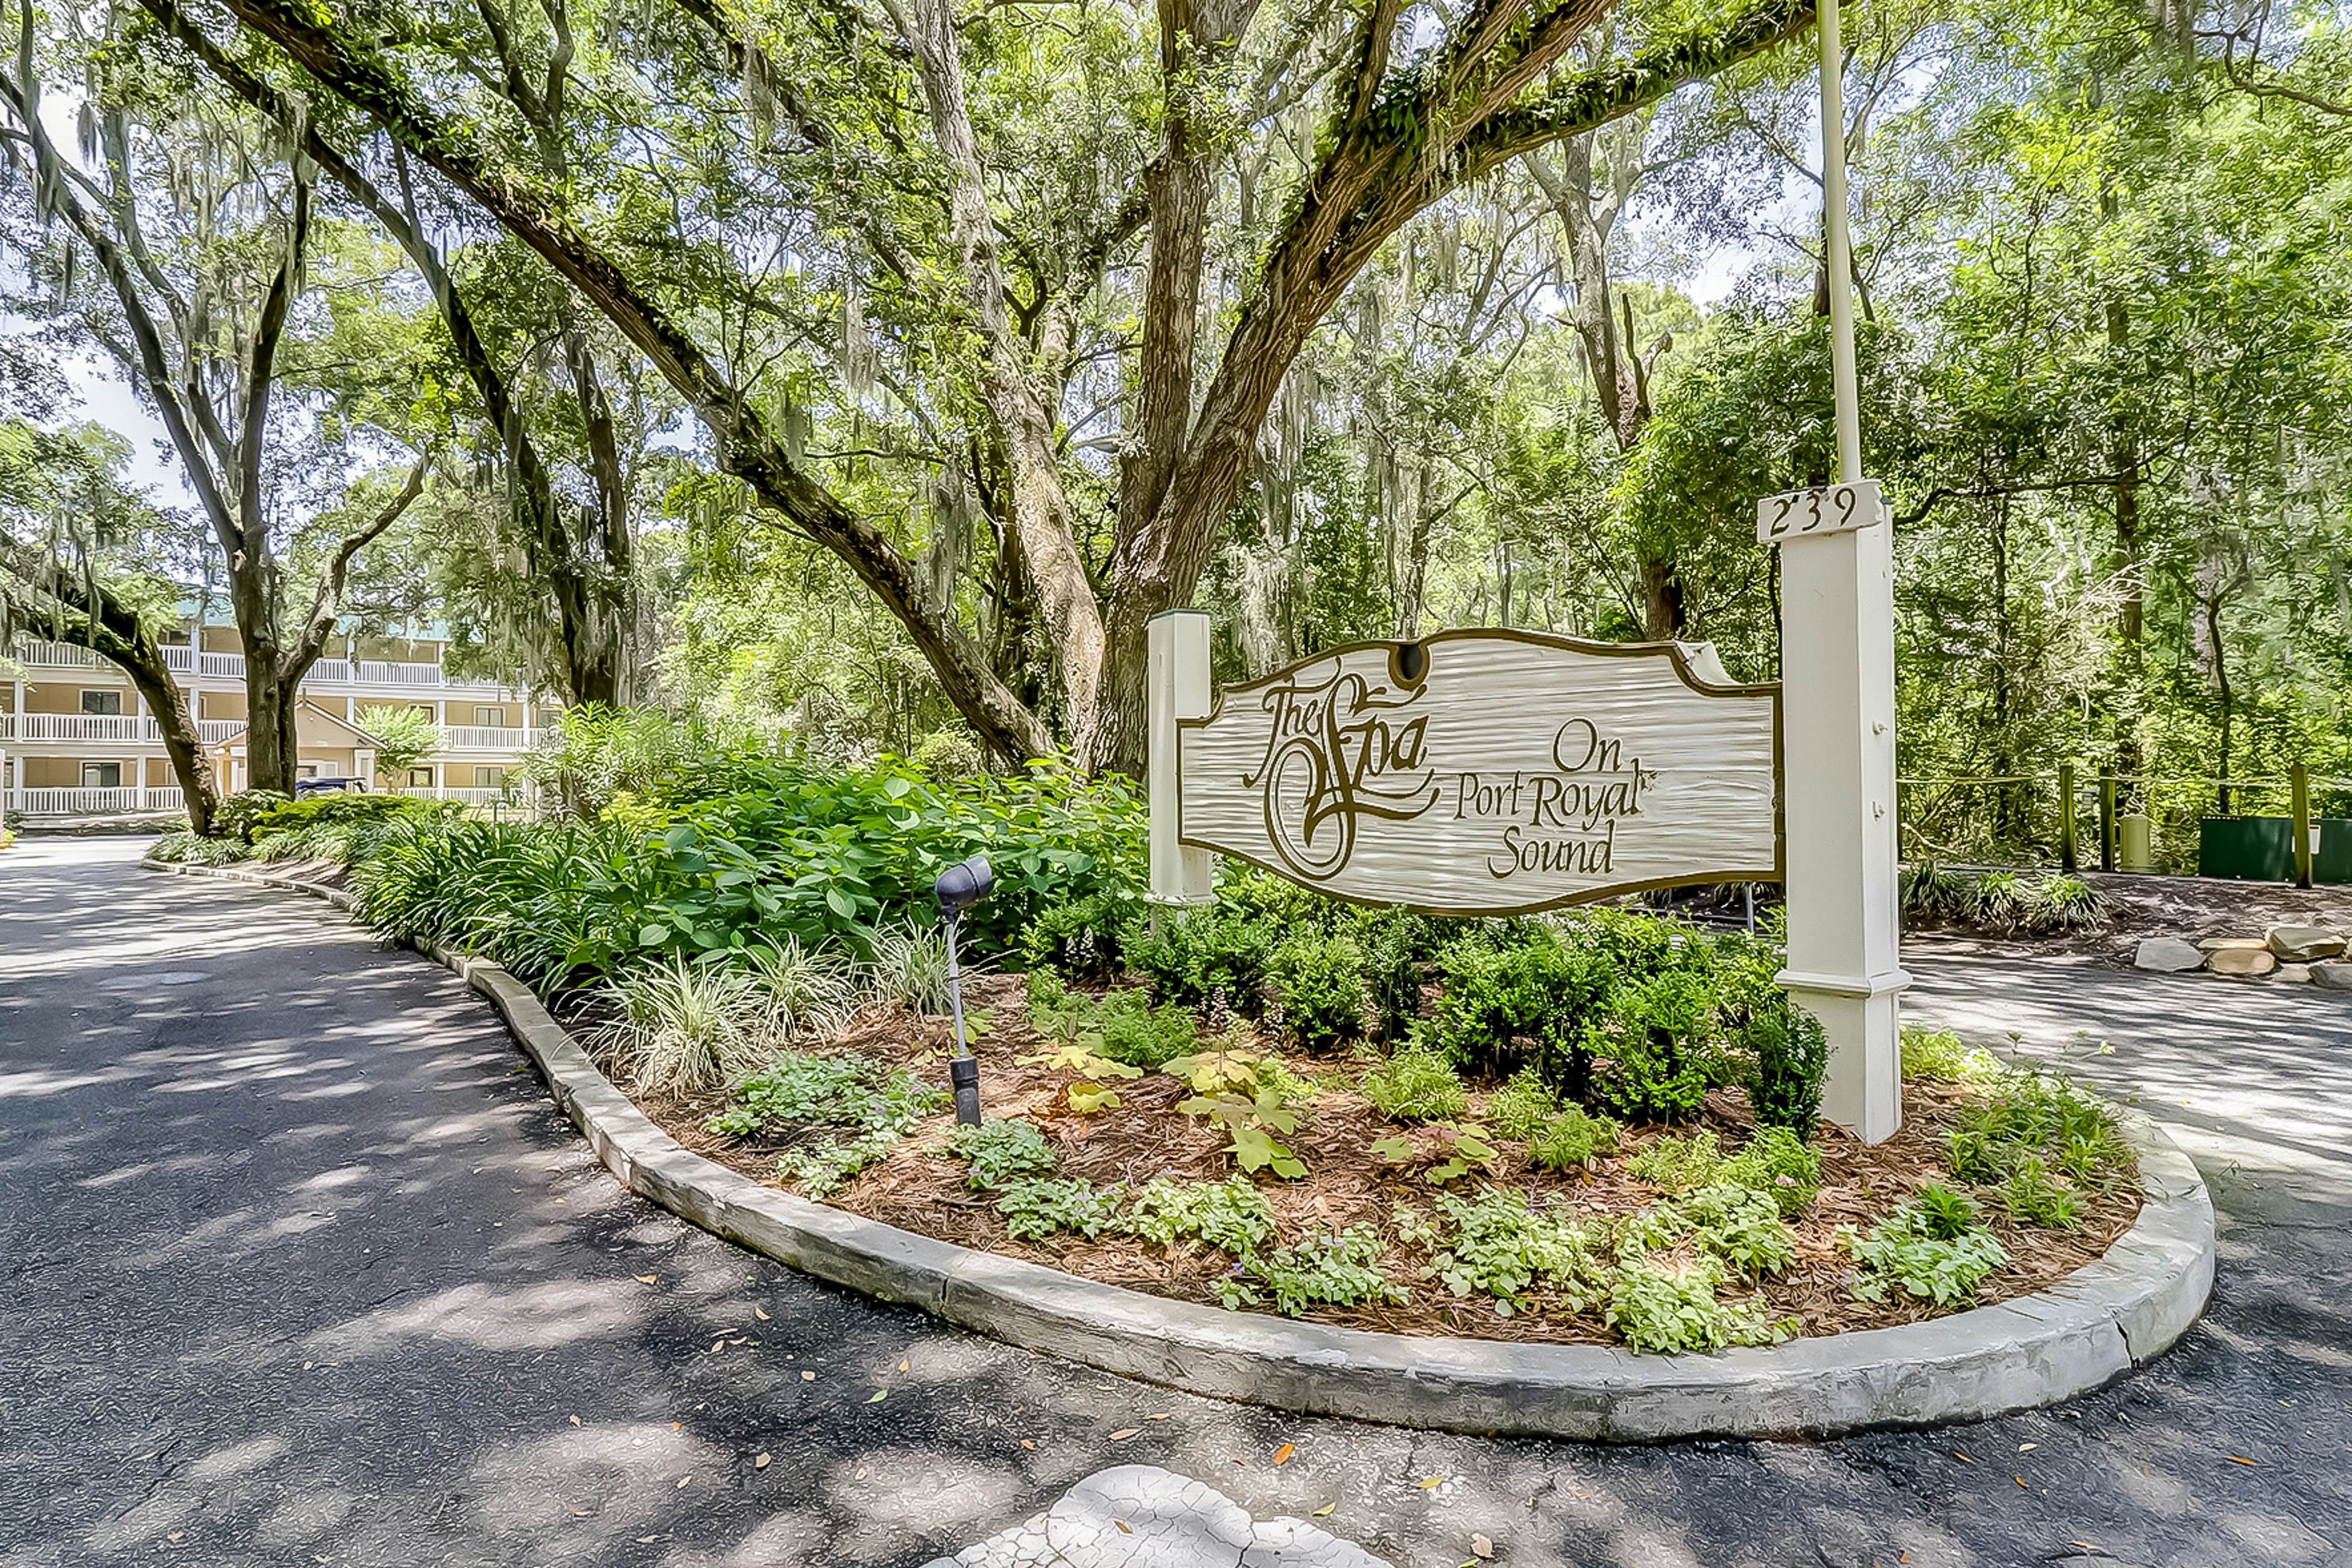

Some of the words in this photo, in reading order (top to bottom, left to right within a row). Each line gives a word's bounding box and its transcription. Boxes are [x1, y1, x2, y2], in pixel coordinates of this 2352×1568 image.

[1769, 487, 1856, 537] 239
[1243, 656, 1342, 788] The
[1553, 718, 1622, 773] On
[1265, 673, 1440, 881] Spa
[1453, 770, 1525, 820] Port
[1528, 757, 1642, 831] Royal
[1487, 818, 1614, 879] Sound
